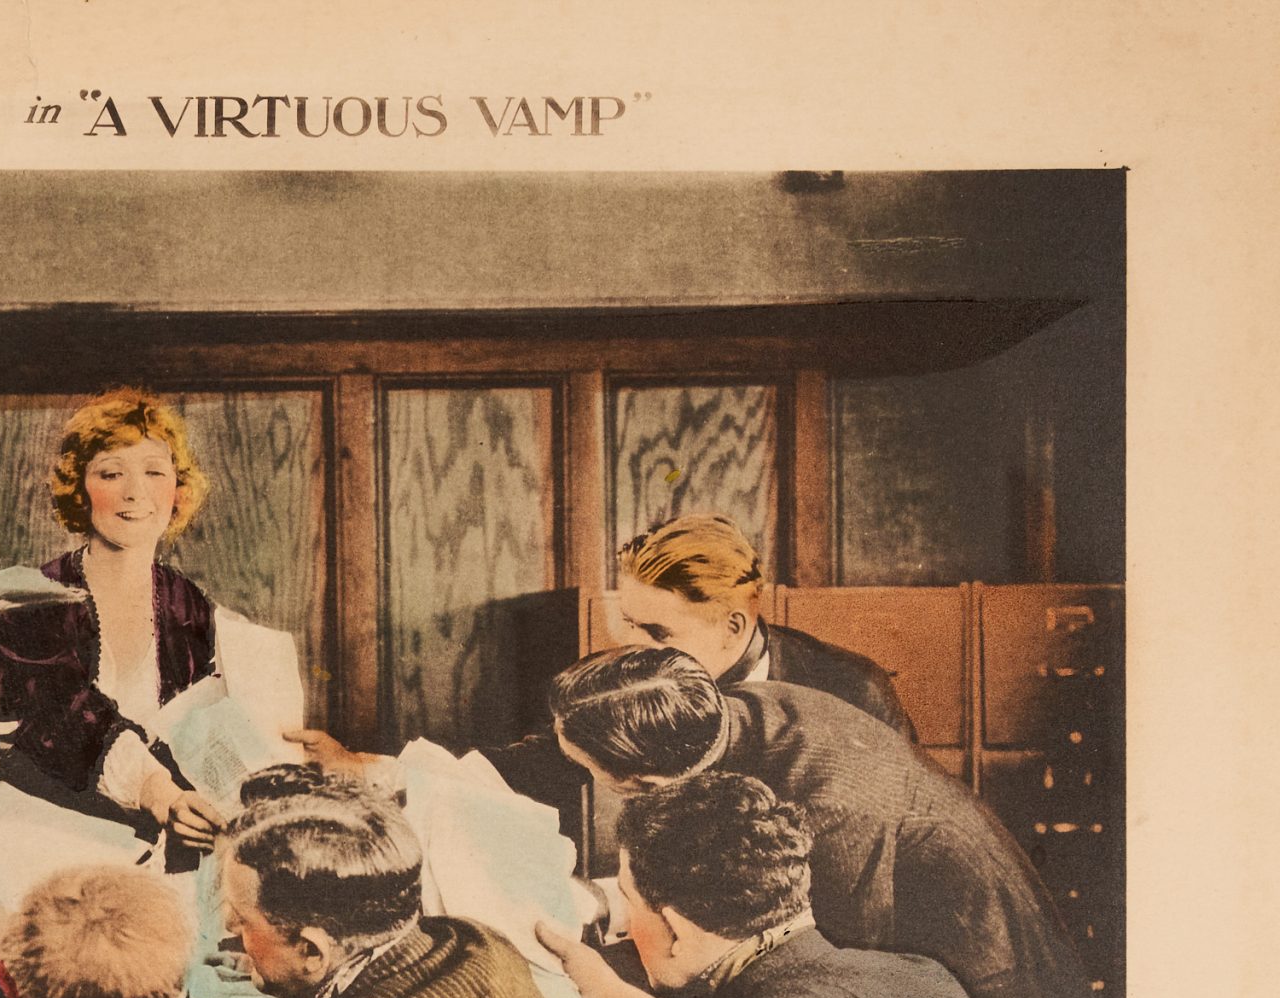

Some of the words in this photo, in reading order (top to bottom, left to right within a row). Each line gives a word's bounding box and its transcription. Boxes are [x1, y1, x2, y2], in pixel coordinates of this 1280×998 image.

[24, 95, 62, 125] in
[147, 94, 448, 138] VIRTUOUS
[470, 91, 653, 137] VAMP"
